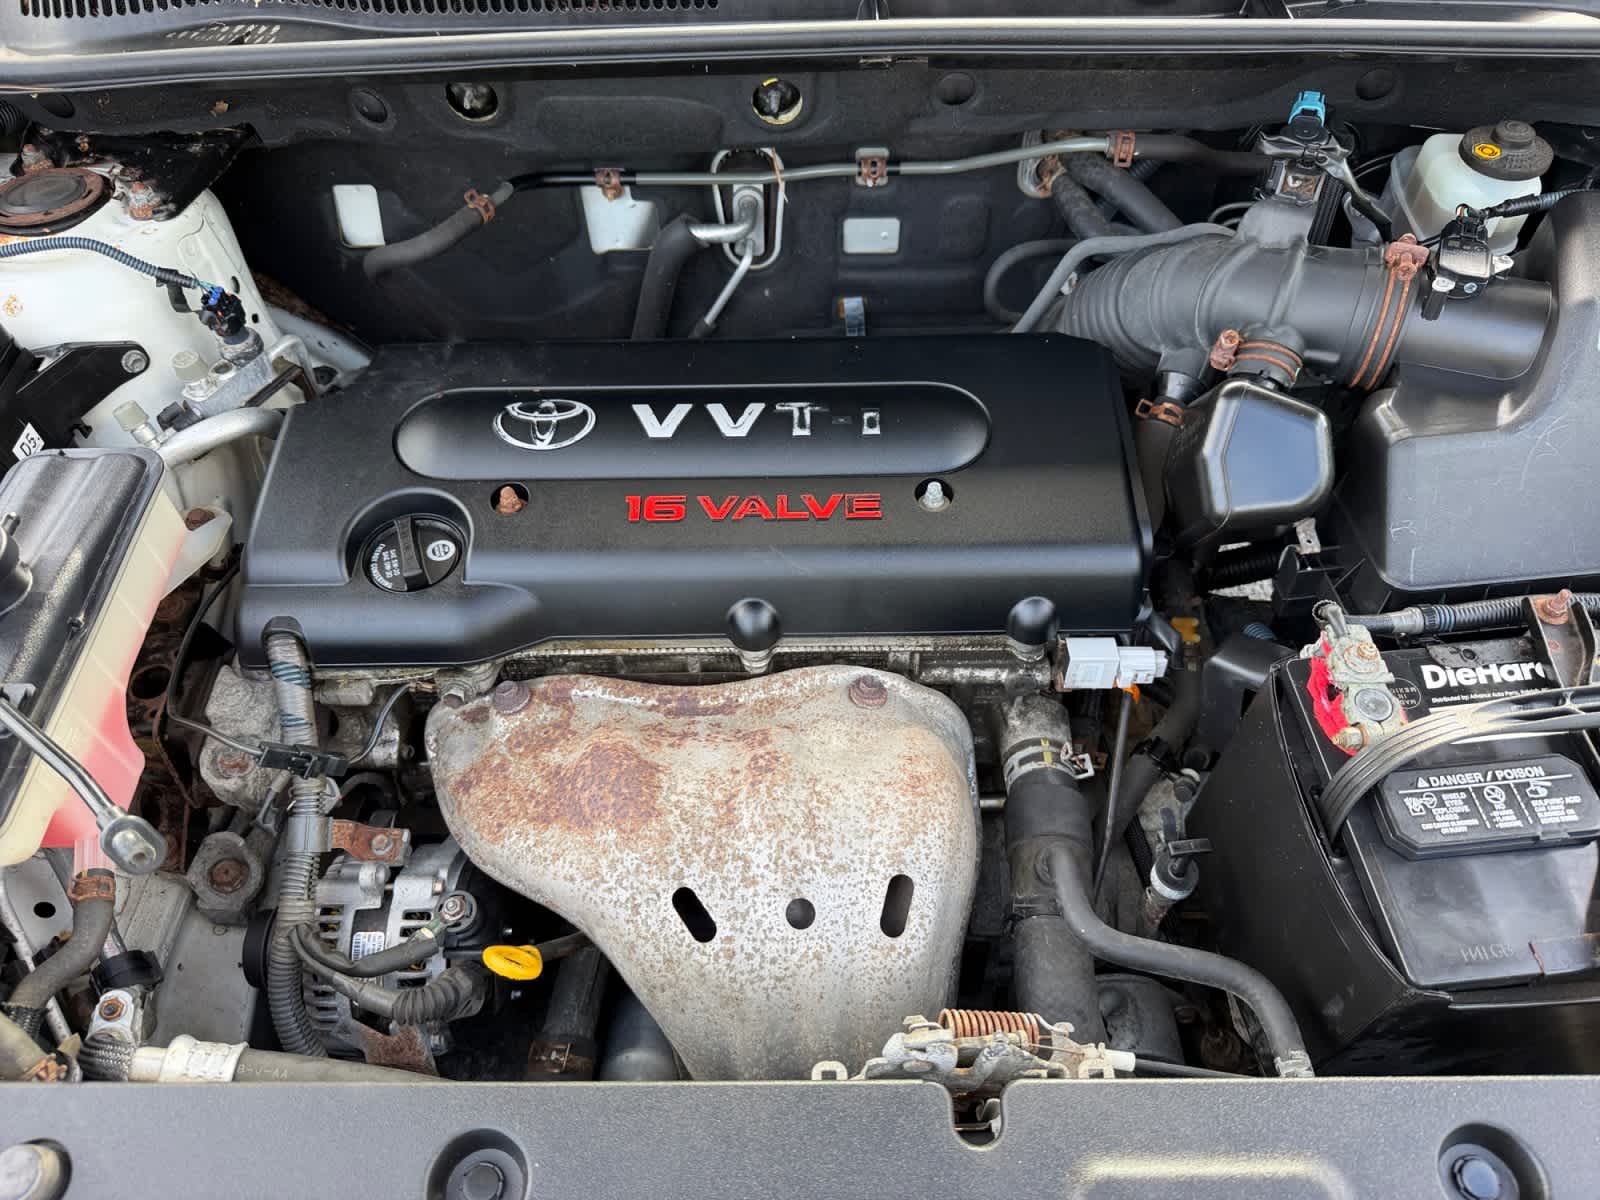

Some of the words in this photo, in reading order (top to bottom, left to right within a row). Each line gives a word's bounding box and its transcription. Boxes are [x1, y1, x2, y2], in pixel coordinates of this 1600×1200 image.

[625, 495, 687, 521] 16
[697, 493, 882, 521] VALVE
[1429, 772, 1485, 787] DANGER
[1495, 766, 1545, 781] POISON
